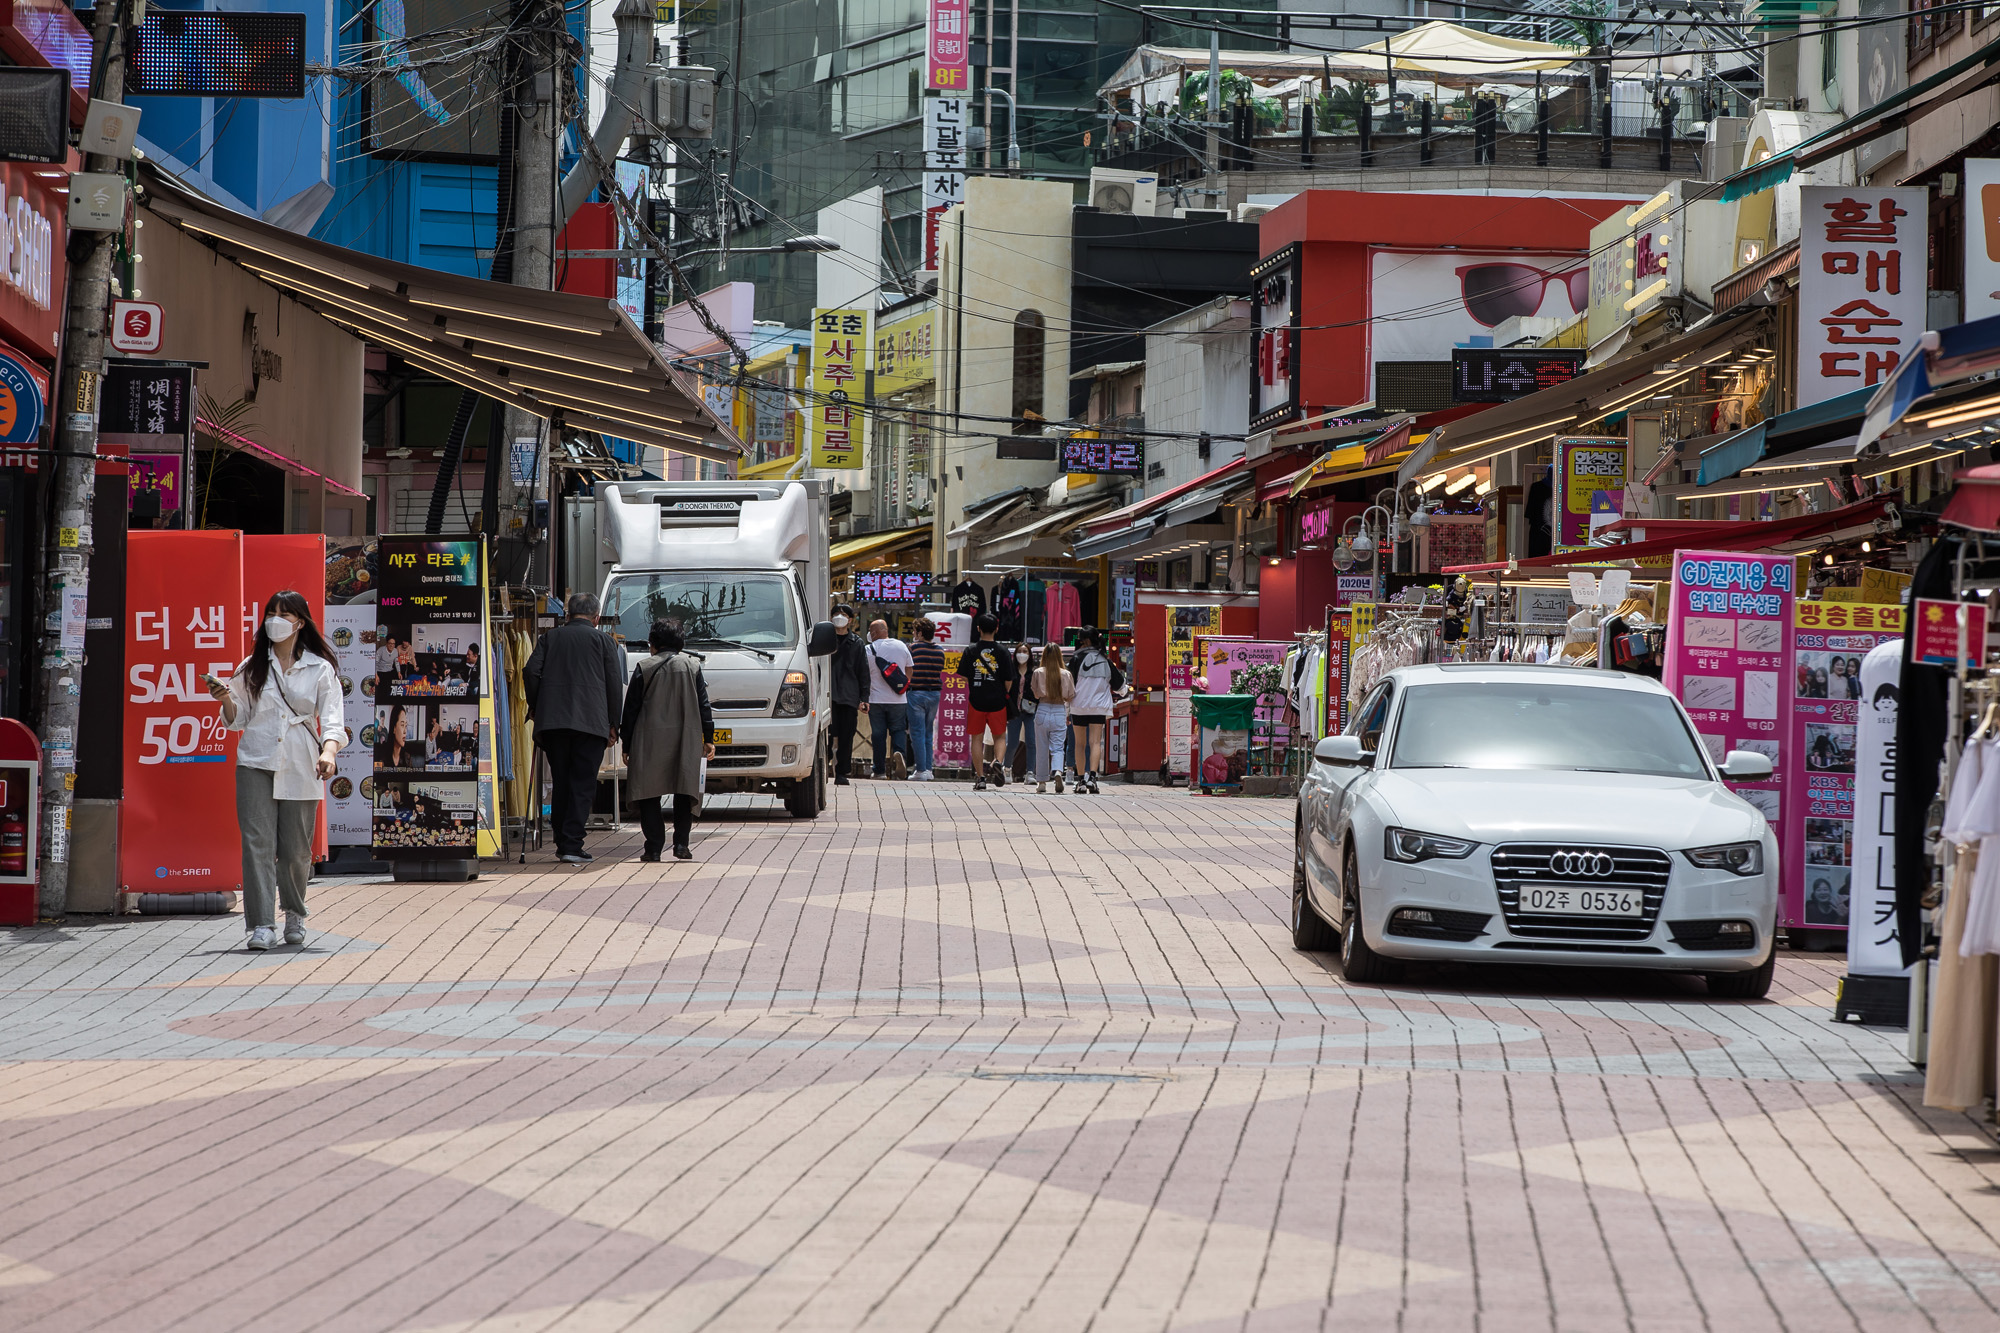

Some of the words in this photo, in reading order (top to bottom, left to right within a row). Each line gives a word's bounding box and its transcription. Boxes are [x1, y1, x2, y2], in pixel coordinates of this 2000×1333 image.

[935, 67, 962, 85] 8F
[934, 99, 962, 197] 건달포차
[1819, 197, 1907, 387] 할매순대
[818, 313, 863, 335] 포춘
[877, 333, 894, 377] 포춘
[147, 379, 170, 435] 调味猪
[826, 454, 849, 464] 2F
[1574, 450, 1624, 465] 화성인
[1574, 464, 1624, 476] 바이러스
[388, 554, 417, 568] 사주
[427, 554, 454, 568] 타로
[1340, 578, 1370, 588] 2020년
[1680, 560, 1767, 592] GD권지용
[1770, 564, 1791, 592] 외
[1866, 570, 1904, 590] SALE
[859, 575, 924, 598] 취업운
[382, 598, 402, 606] MBC
[1690, 590, 1728, 613] 연예인
[1730, 592, 1782, 616] 다수상담
[1800, 604, 1900, 629] 방송출연
[136, 606, 170, 650] 더
[186, 606, 225, 648] 샘
[1332, 620, 1340, 632] 킬
[1796, 635, 1824, 648] KBS
[1331, 640, 1340, 678] 지성화
[1172, 668, 1186, 676] 사주
[130, 662, 234, 704] SALE
[944, 677, 966, 688] 상담
[1172, 678, 1186, 686] 타로
[944, 693, 966, 704] 사주
[944, 709, 965, 720] 타로
[1328, 696, 1338, 735] 타로사
[943, 726, 966, 738] 궁합
[1760, 721, 1774, 730] GD
[200, 743, 212, 754] up
[214, 742, 224, 752] to
[942, 741, 966, 753] 관상
[1811, 802, 1853, 814] 유튜브
[330, 824, 346, 833] 루타
[1531, 889, 1570, 910] 02주
[1580, 894, 1632, 912] 0536
